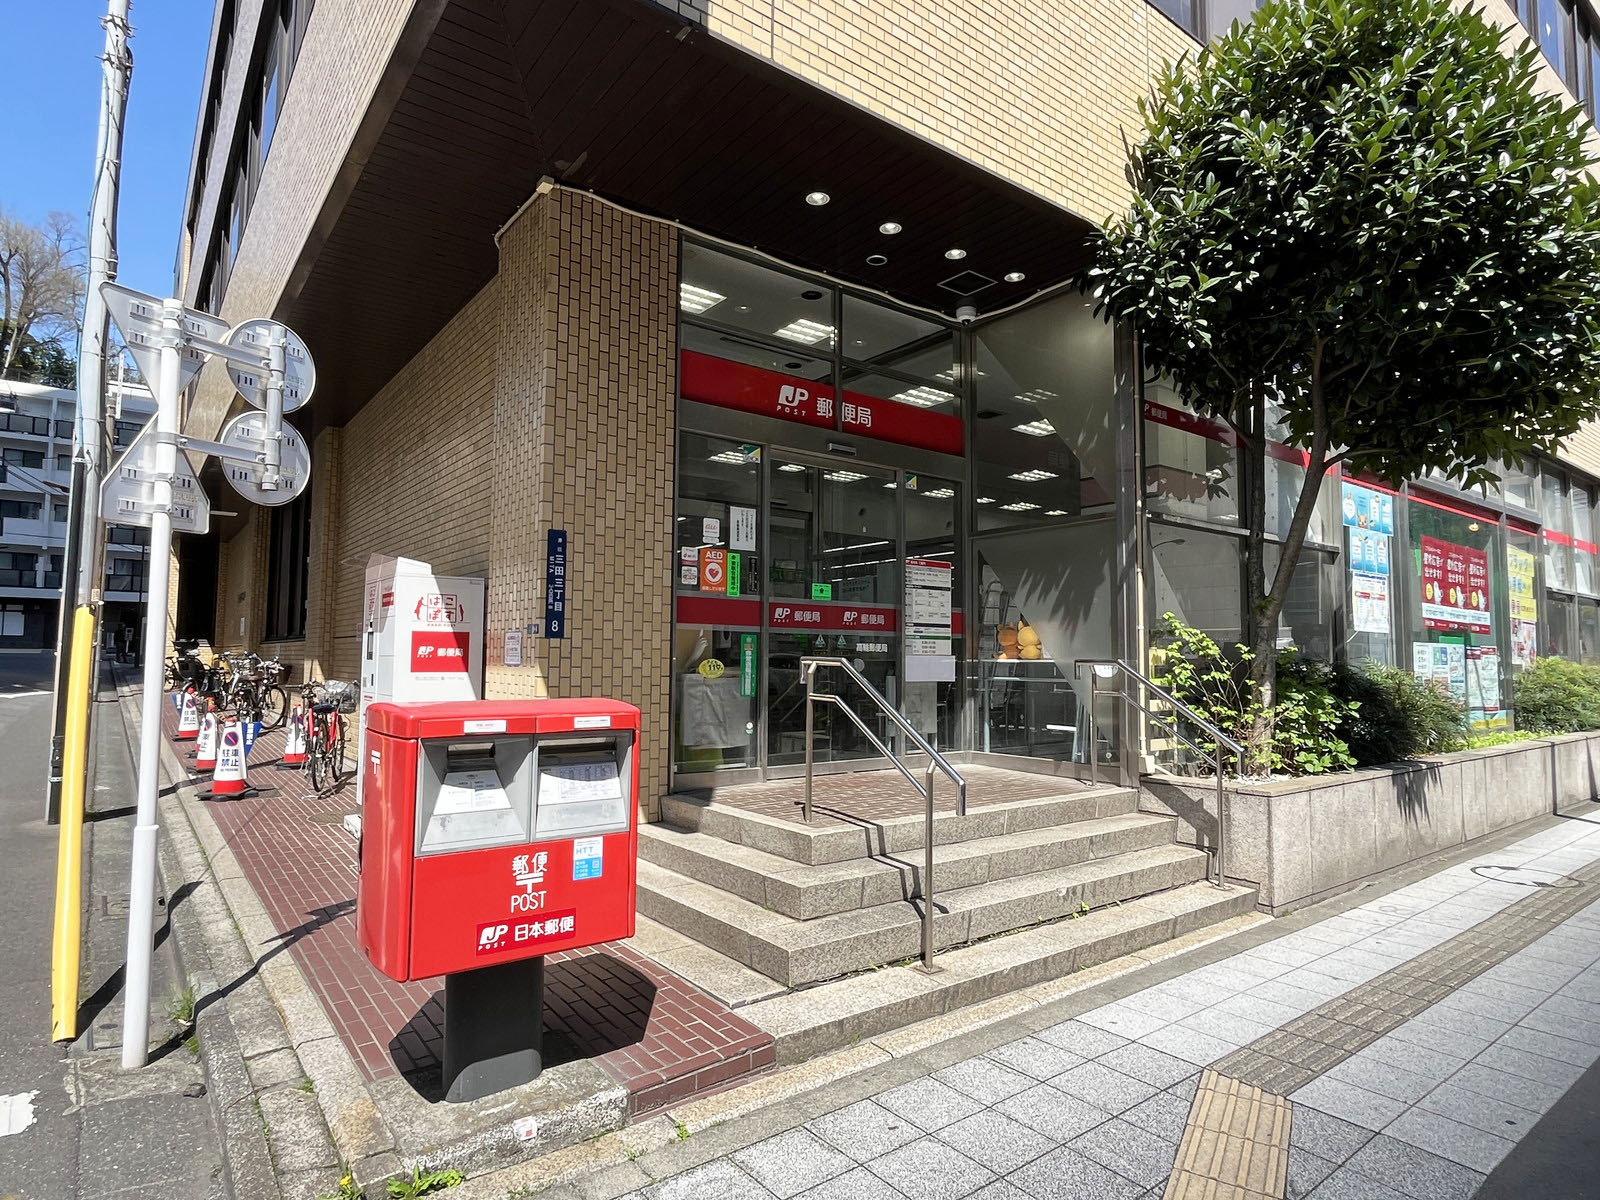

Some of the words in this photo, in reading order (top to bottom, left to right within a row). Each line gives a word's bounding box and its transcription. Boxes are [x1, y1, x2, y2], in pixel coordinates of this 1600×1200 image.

[776, 405, 806, 417] POST
[778, 385, 808, 407] JP
[817, 398, 871, 427] 郵便局
[705, 551, 723, 560] AED
[554, 554, 564, 612] 三田三丁目
[774, 607, 791, 619] JP
[794, 610, 821, 623] 郵便局
[843, 611, 858, 622] JP
[860, 613, 885, 625] 郵便局
[551, 619, 559, 632] 8
[437, 647, 464, 657] 郵便局
[222, 749, 239, 758] 駐車
[221, 758, 239, 767] 禁止
[512, 851, 548, 876] 郵便
[511, 890, 547, 913] POST
[480, 924, 509, 945] JP
[514, 915, 575, 942] 日本郵便
[478, 941, 506, 951] POST
